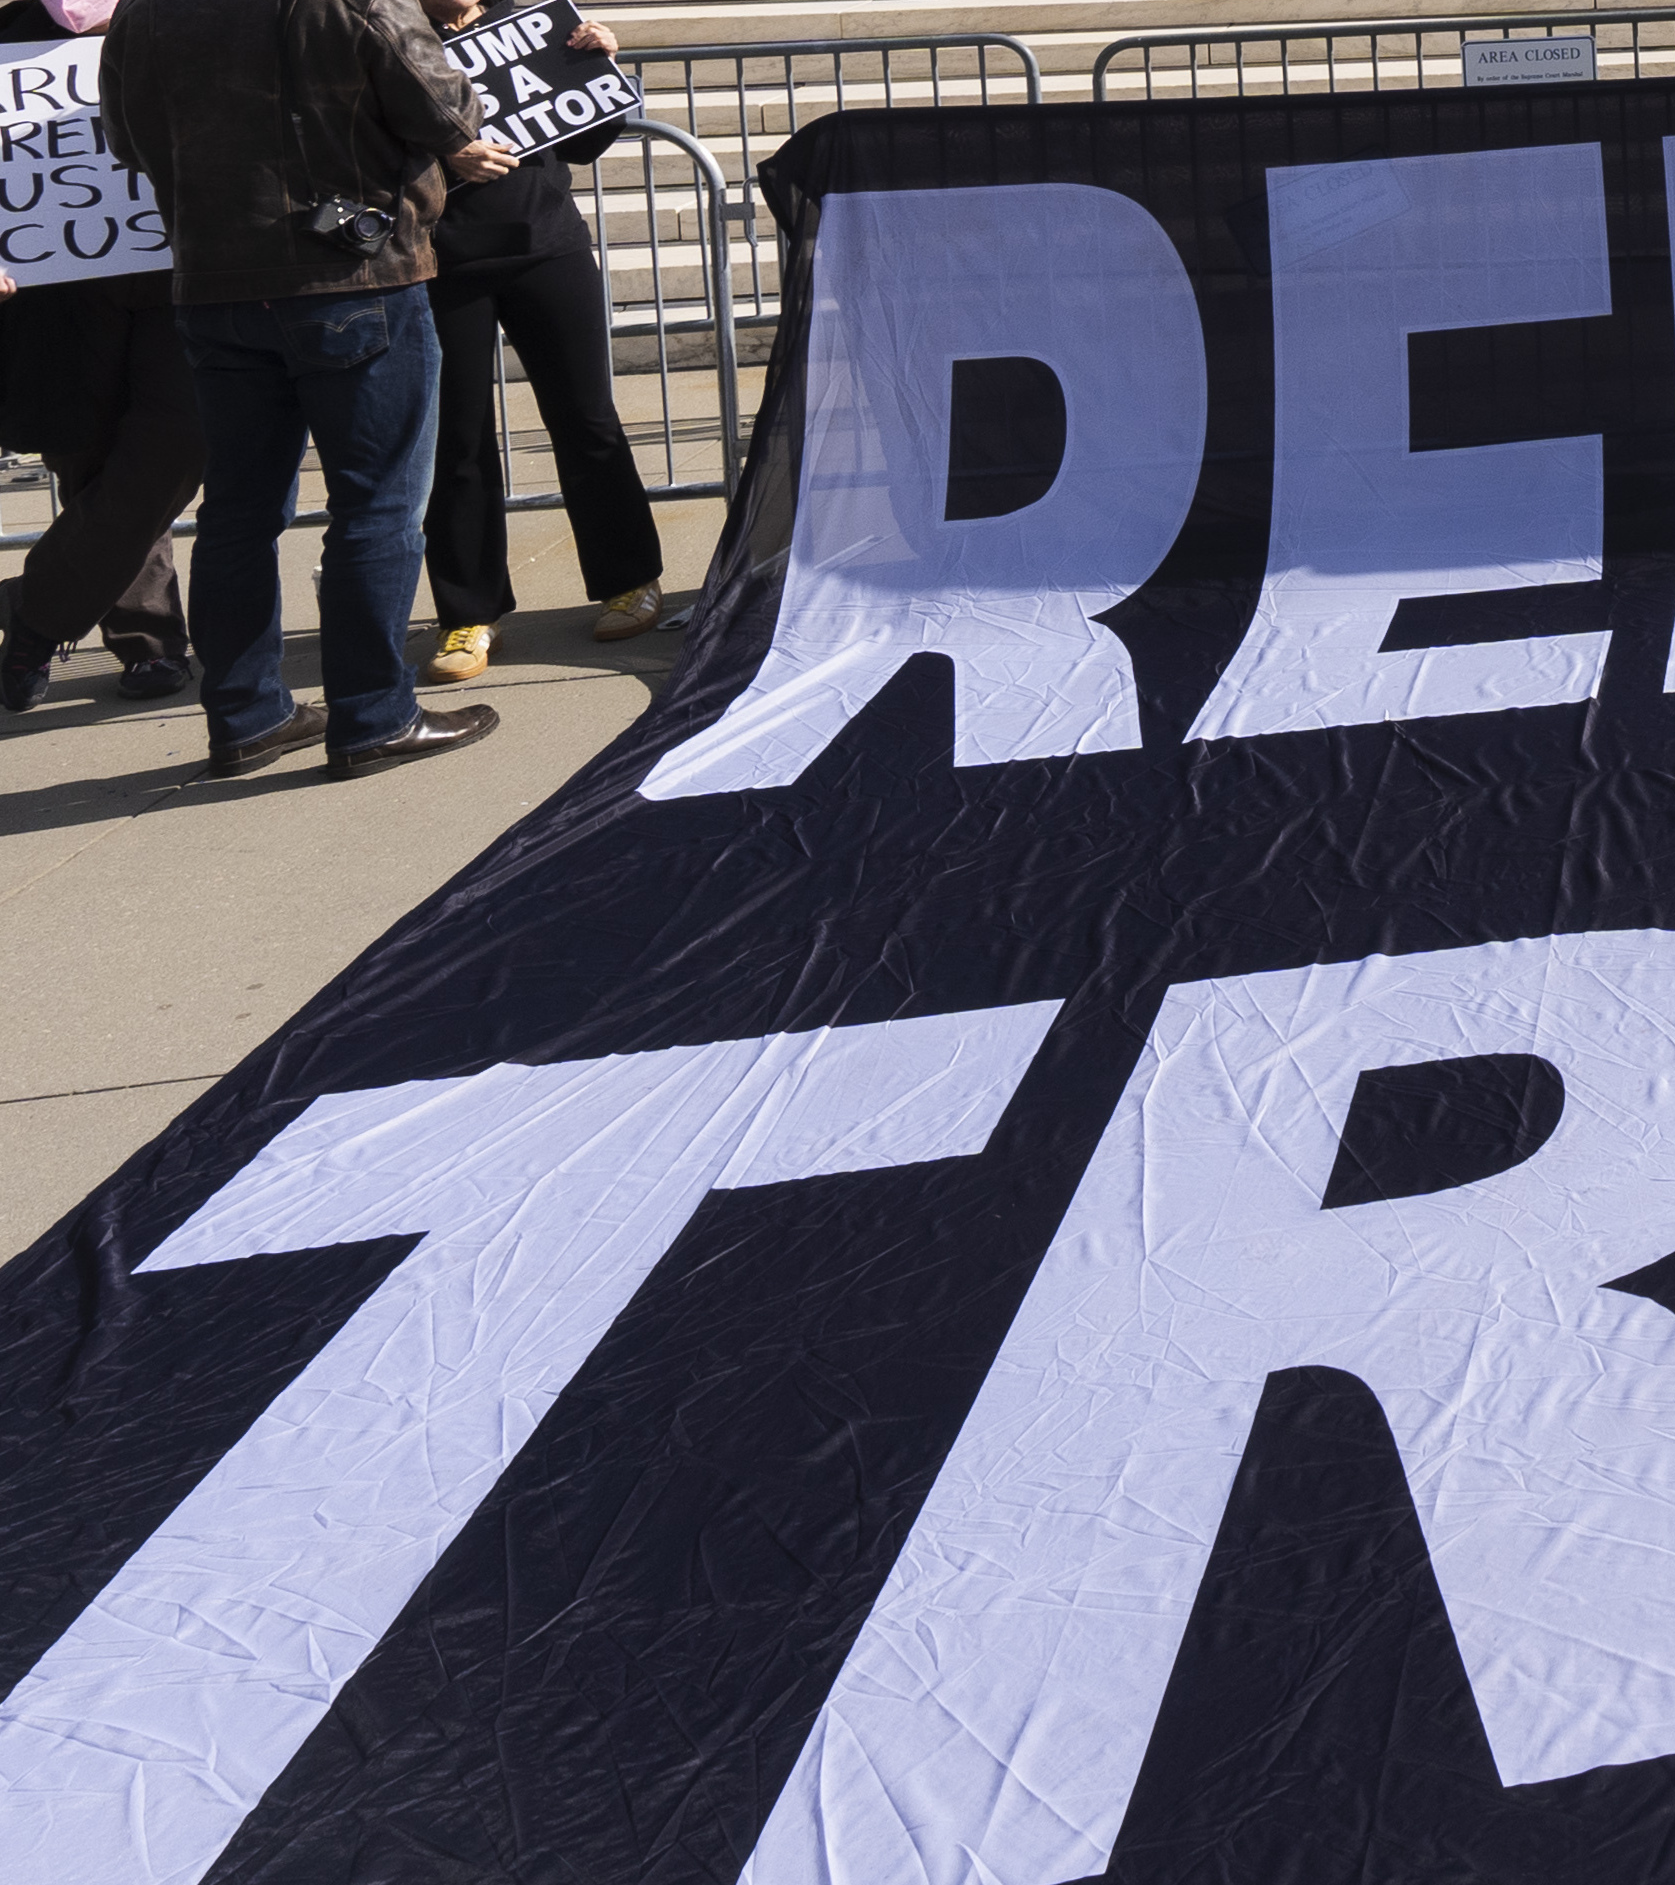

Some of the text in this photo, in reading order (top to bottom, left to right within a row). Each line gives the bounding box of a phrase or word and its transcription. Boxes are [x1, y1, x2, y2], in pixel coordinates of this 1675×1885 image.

[445, 12, 553, 78] UMP
[1478, 47, 1581, 64] AREA CLOSED
[471, 65, 553, 119] S A
[479, 74, 635, 154] AITOR
